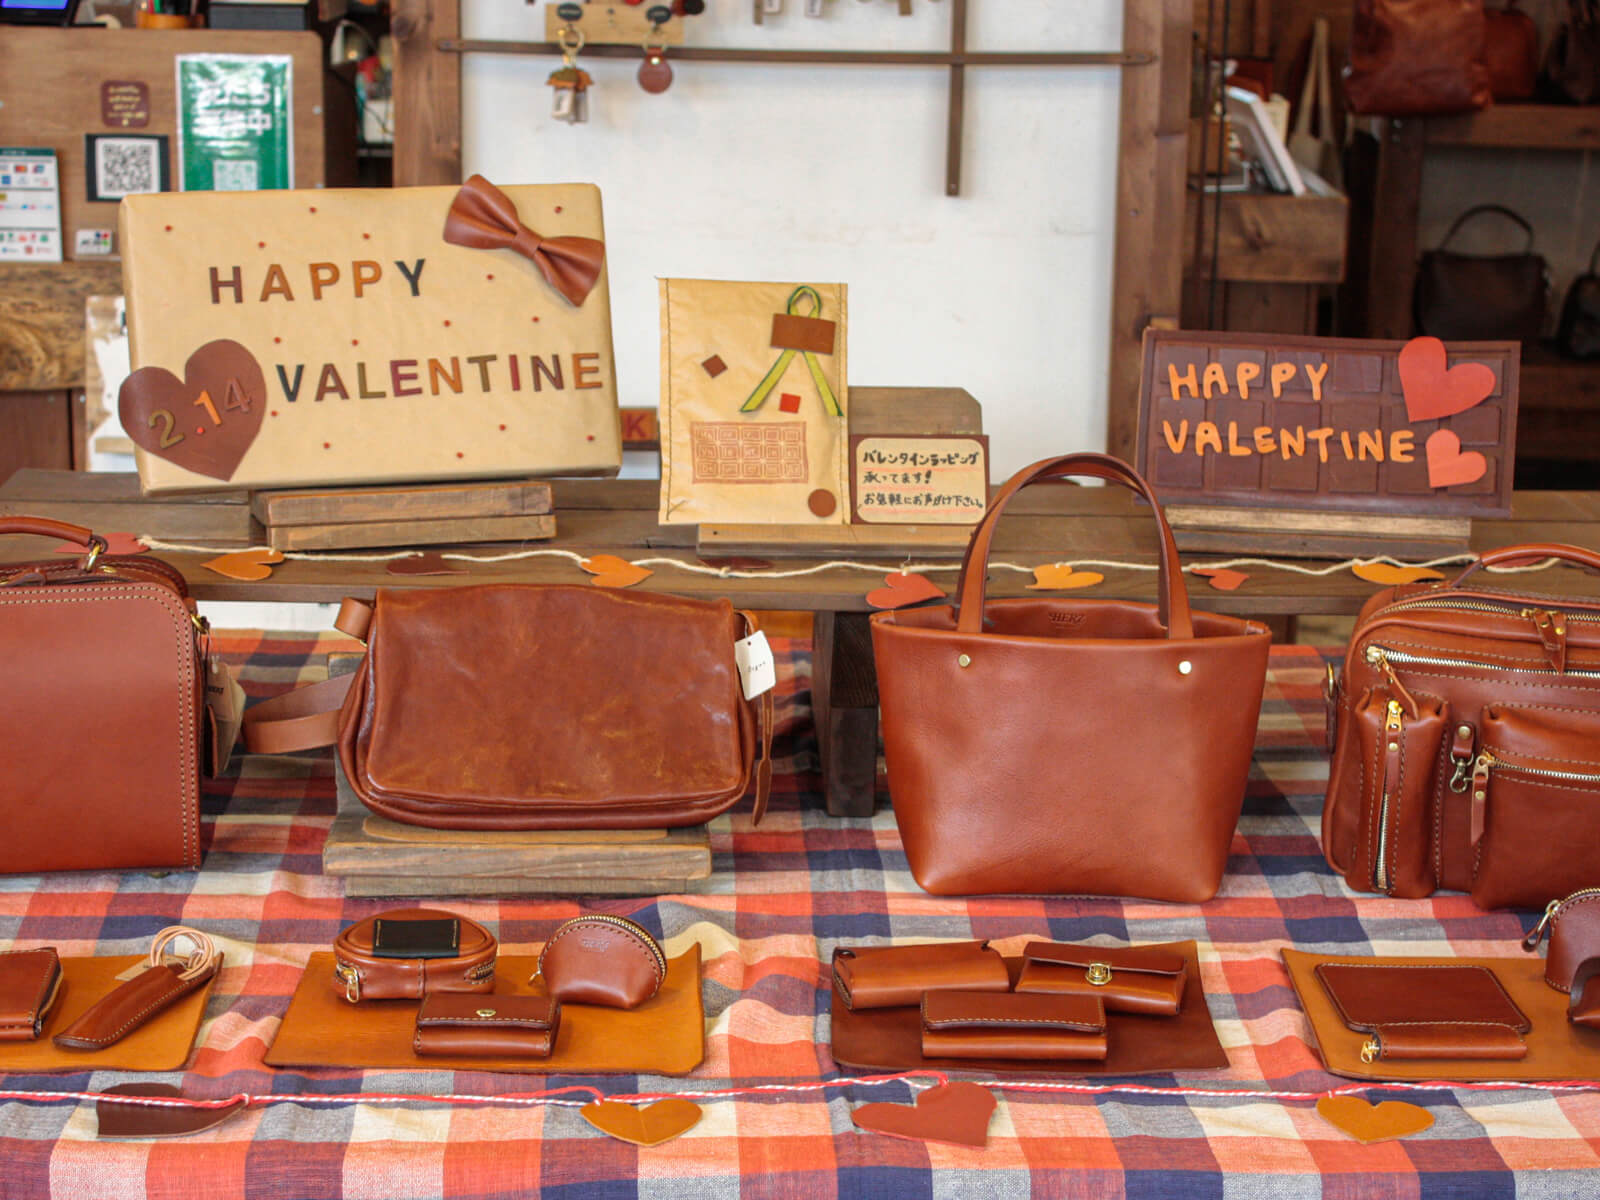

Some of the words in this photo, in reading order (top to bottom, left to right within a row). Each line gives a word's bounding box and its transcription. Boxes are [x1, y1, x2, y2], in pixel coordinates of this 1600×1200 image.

[208, 258, 427, 304] HAPPY
[275, 352, 604, 403] VALENTINE
[1168, 361, 1328, 400] HAPPY
[147, 376, 252, 450] 2.14
[863, 449, 979, 466] バレンタインラッピング
[1163, 419, 1415, 463] VALENTINE
